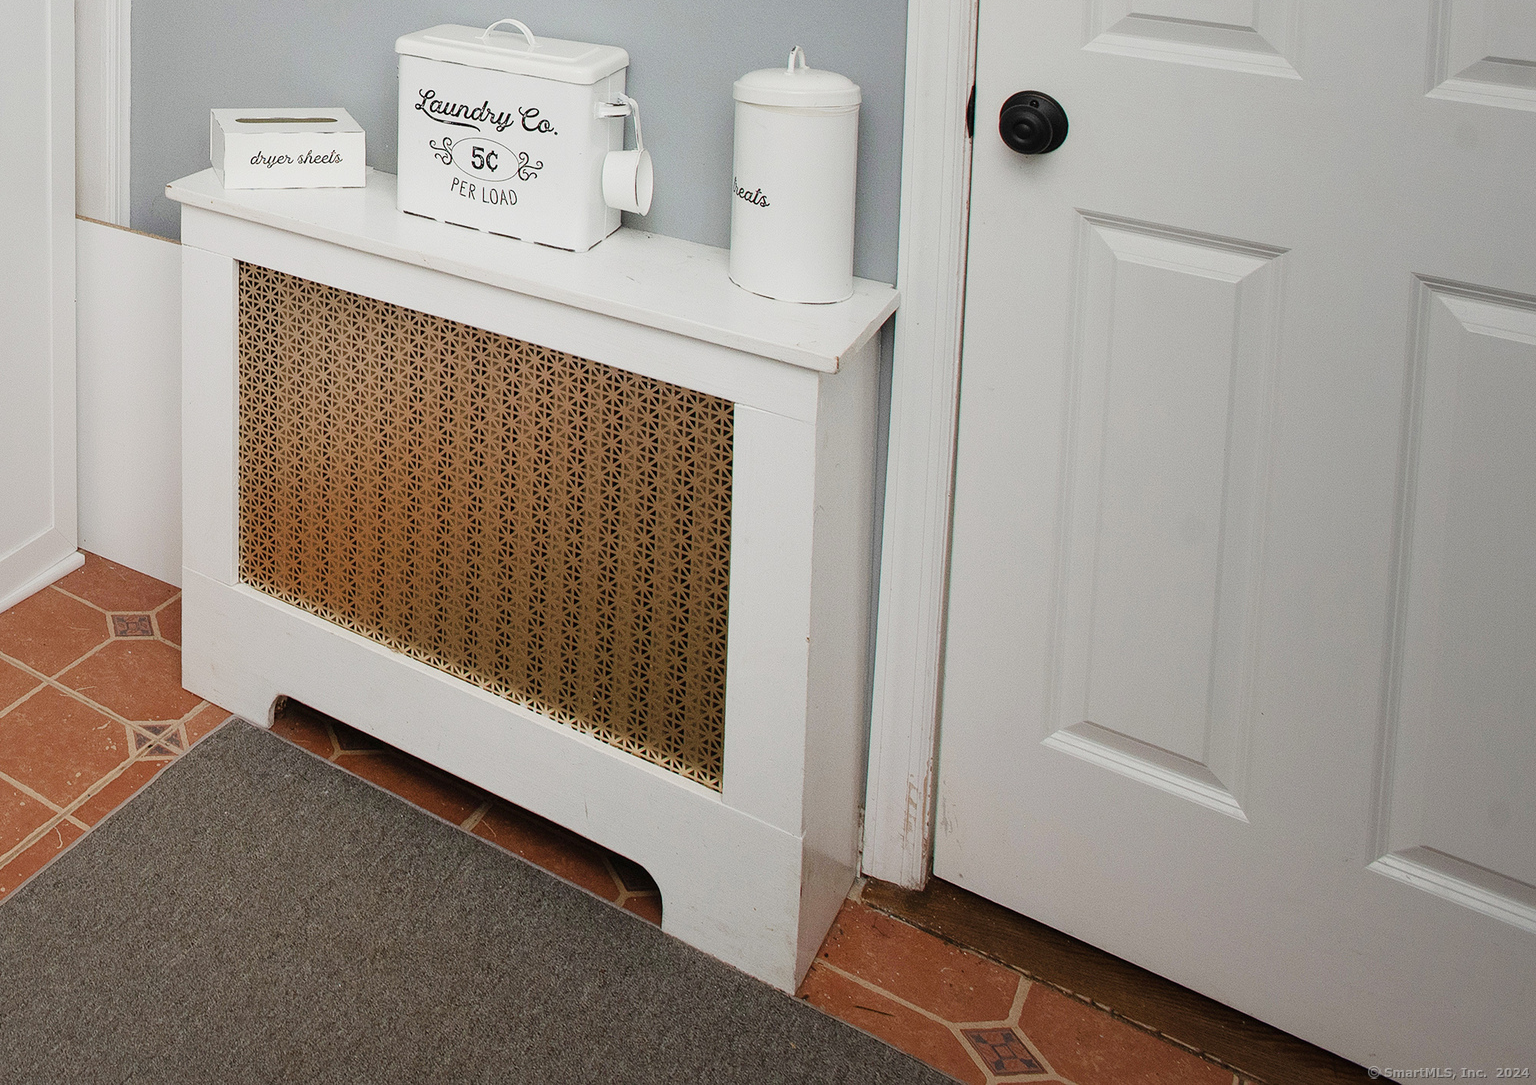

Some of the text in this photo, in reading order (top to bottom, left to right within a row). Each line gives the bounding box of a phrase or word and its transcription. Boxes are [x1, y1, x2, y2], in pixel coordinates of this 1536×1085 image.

[414, 88, 559, 136] Laundry Co.
[250, 149, 344, 169] dryer sheets
[470, 145, 499, 173] 5¢
[450, 177, 518, 206] PER LOAD
